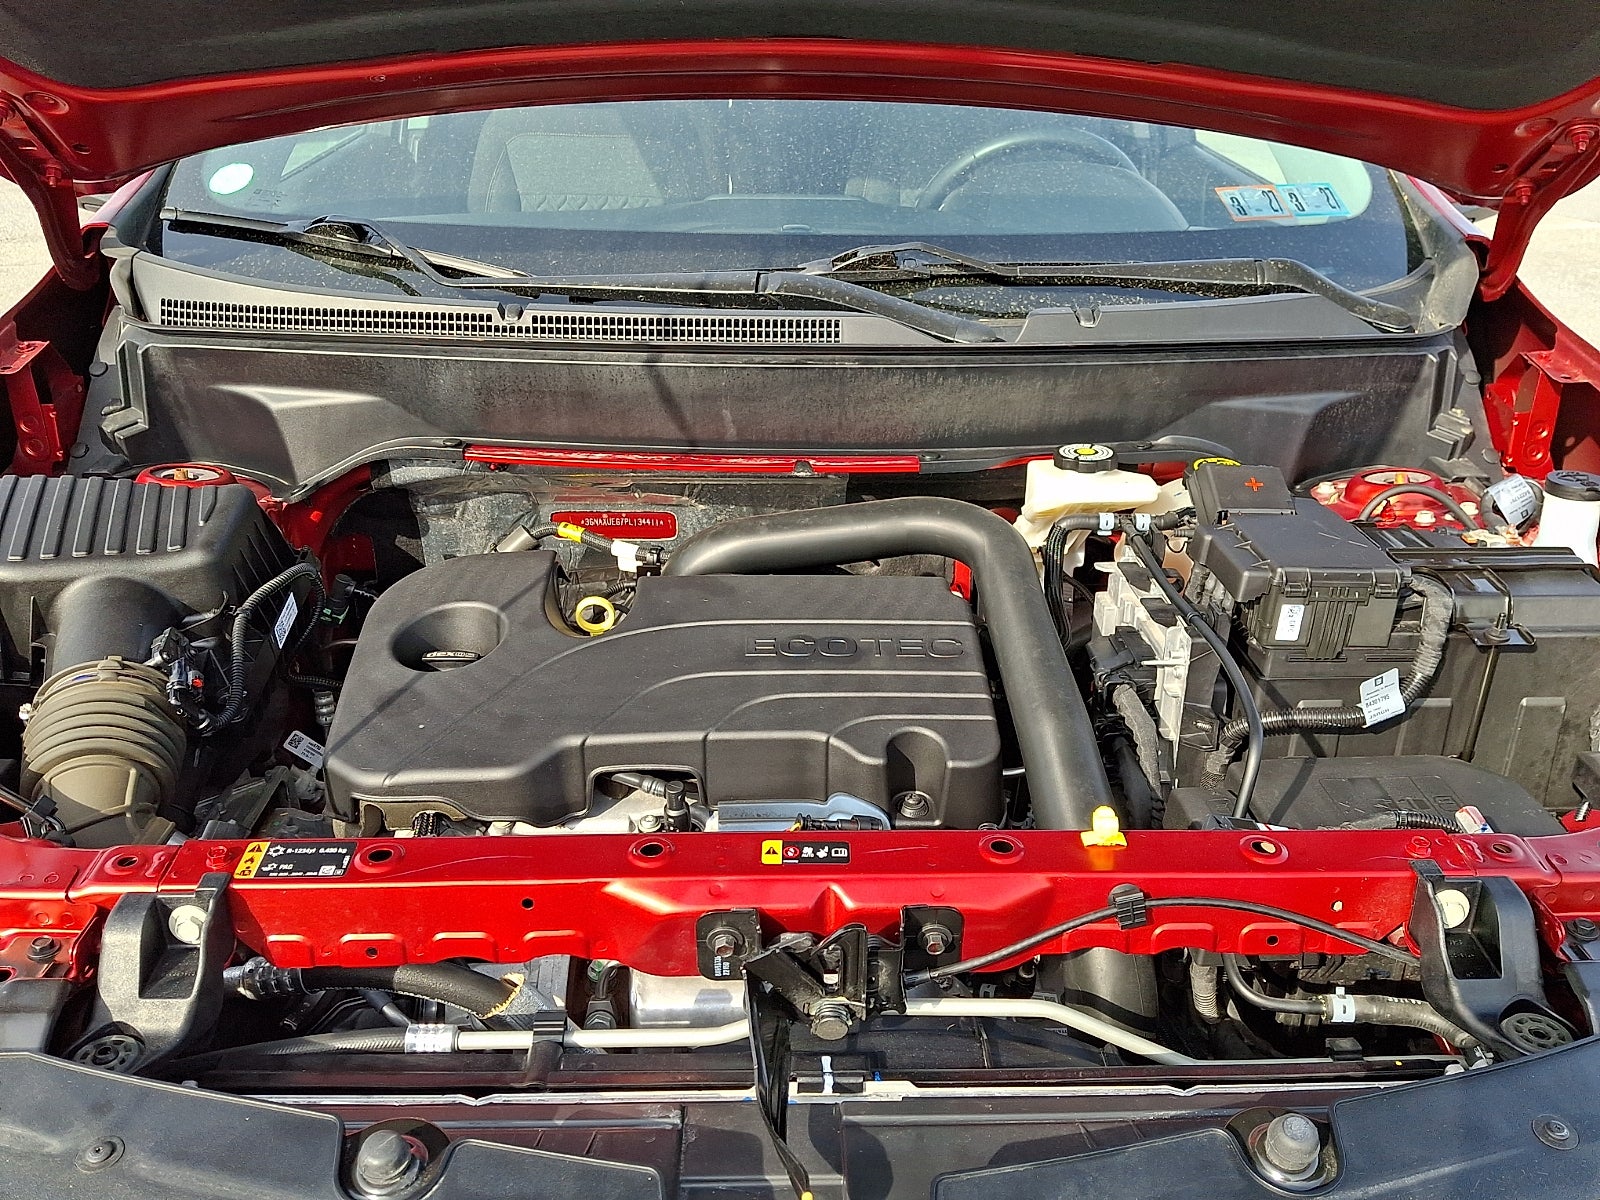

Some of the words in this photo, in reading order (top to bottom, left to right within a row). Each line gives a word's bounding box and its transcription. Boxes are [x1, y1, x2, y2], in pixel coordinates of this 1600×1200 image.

[1229, 196, 1248, 216] 3
[1261, 190, 1284, 213] 27
[1288, 192, 1306, 212] 3
[1318, 187, 1341, 210] 27
[745, 638, 965, 658] ECOTEC
